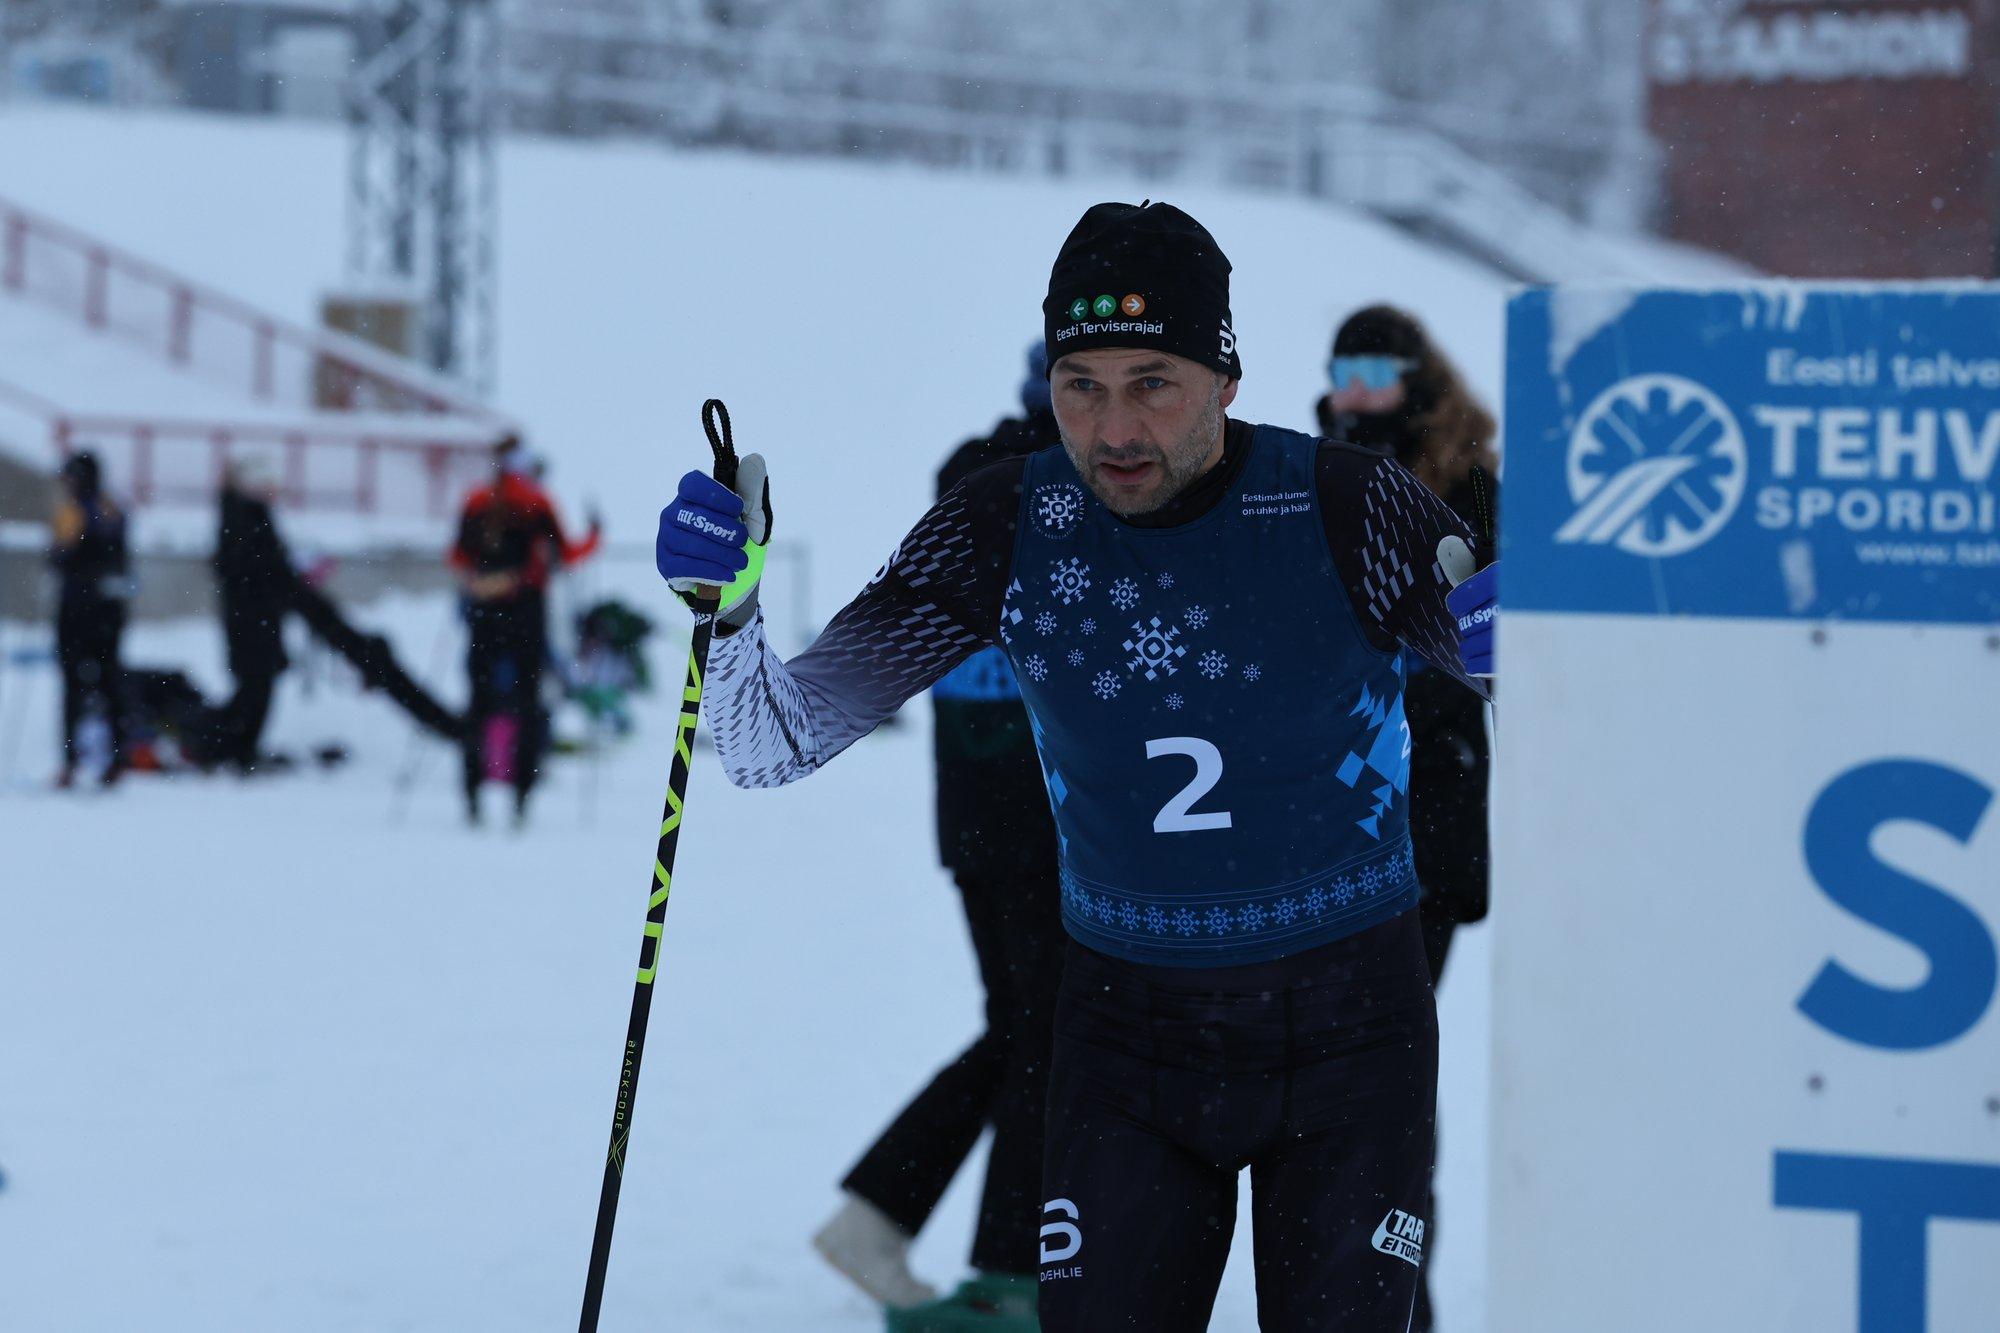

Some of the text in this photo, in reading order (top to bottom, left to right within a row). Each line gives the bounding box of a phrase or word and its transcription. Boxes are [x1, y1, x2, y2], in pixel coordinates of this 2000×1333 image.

[1056, 320, 1163, 341] Eesti Terviserajad
[1767, 349, 1876, 386] Eesti
[1755, 406, 2000, 480] TEHV
[1242, 493, 1283, 502] Eestimaa
[1242, 508, 1255, 516] on
[1256, 506, 1278, 515] uhke
[1280, 504, 1289, 516] ja
[1756, 487, 1994, 533] SPORDI
[1145, 736, 1232, 833] 2
[1797, 757, 1998, 1052] S
[1380, 1236, 1400, 1252] EI
[1772, 1147, 2000, 1333] T
